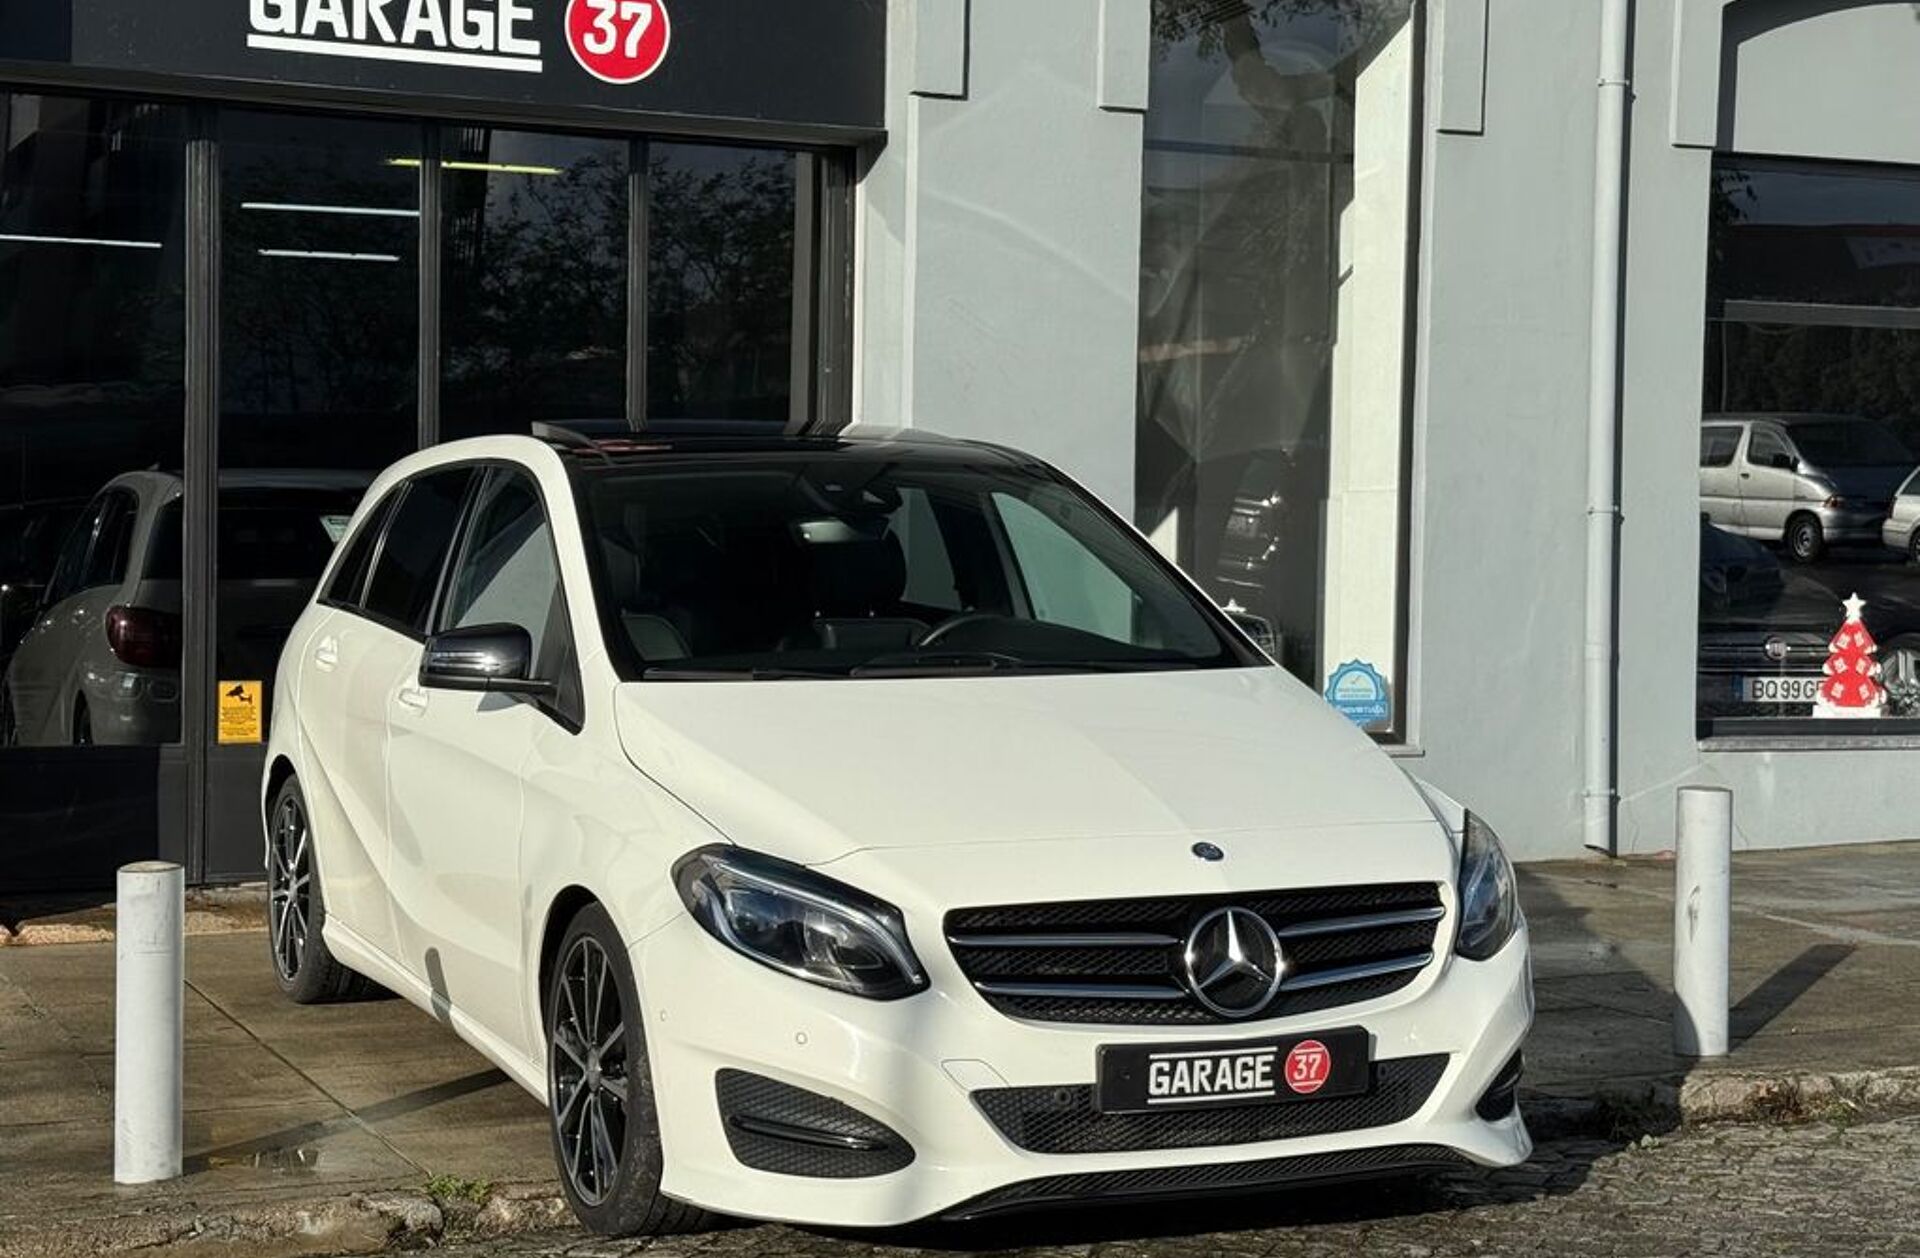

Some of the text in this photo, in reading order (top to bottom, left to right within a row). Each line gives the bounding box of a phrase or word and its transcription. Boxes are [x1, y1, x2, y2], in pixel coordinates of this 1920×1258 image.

[583, 0, 652, 58] 37
[1781, 680, 1800, 699] 99
[1149, 1053, 1322, 1095] GARAGE 37
